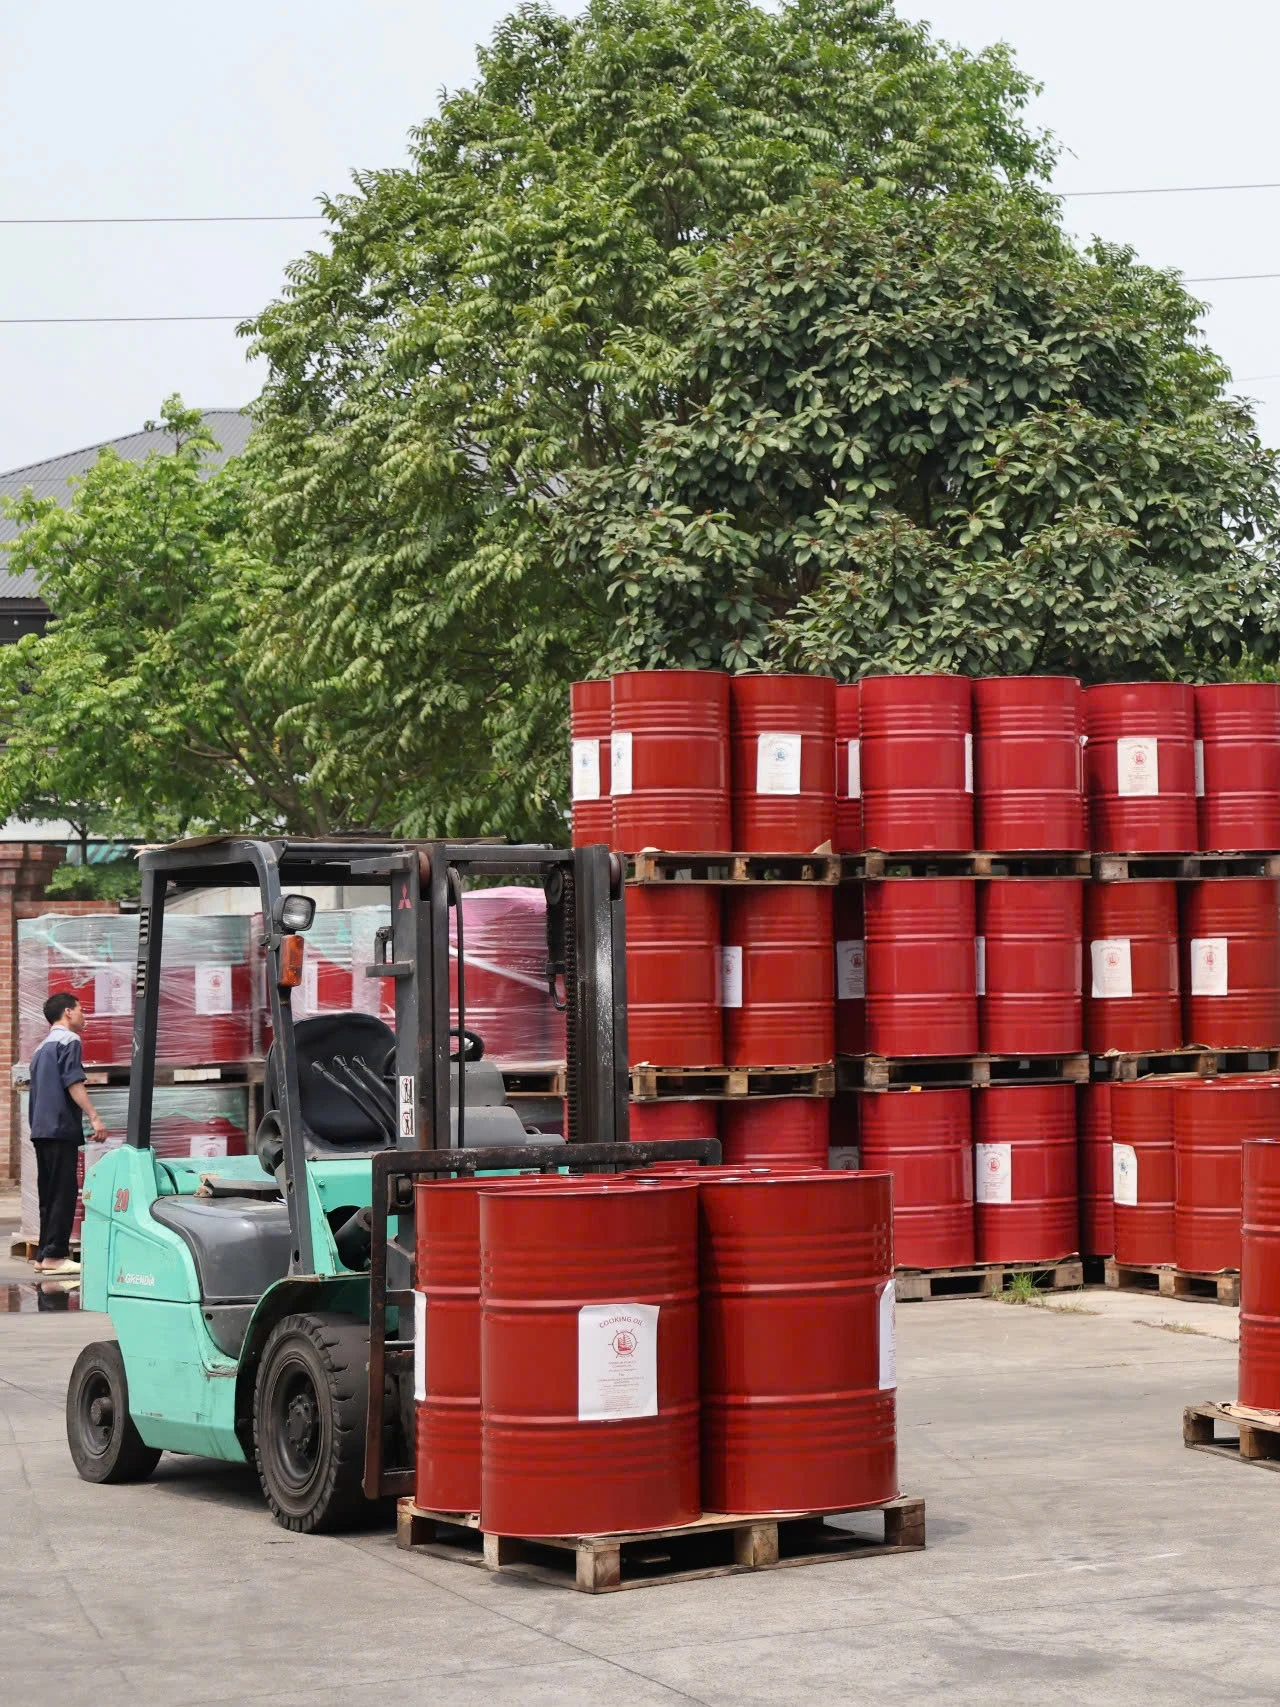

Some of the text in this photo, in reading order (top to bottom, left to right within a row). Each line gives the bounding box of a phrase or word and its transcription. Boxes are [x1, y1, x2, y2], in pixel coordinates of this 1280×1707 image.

[113, 1188, 130, 1212] 20
[600, 1316, 643, 1328] COOKING OIL
